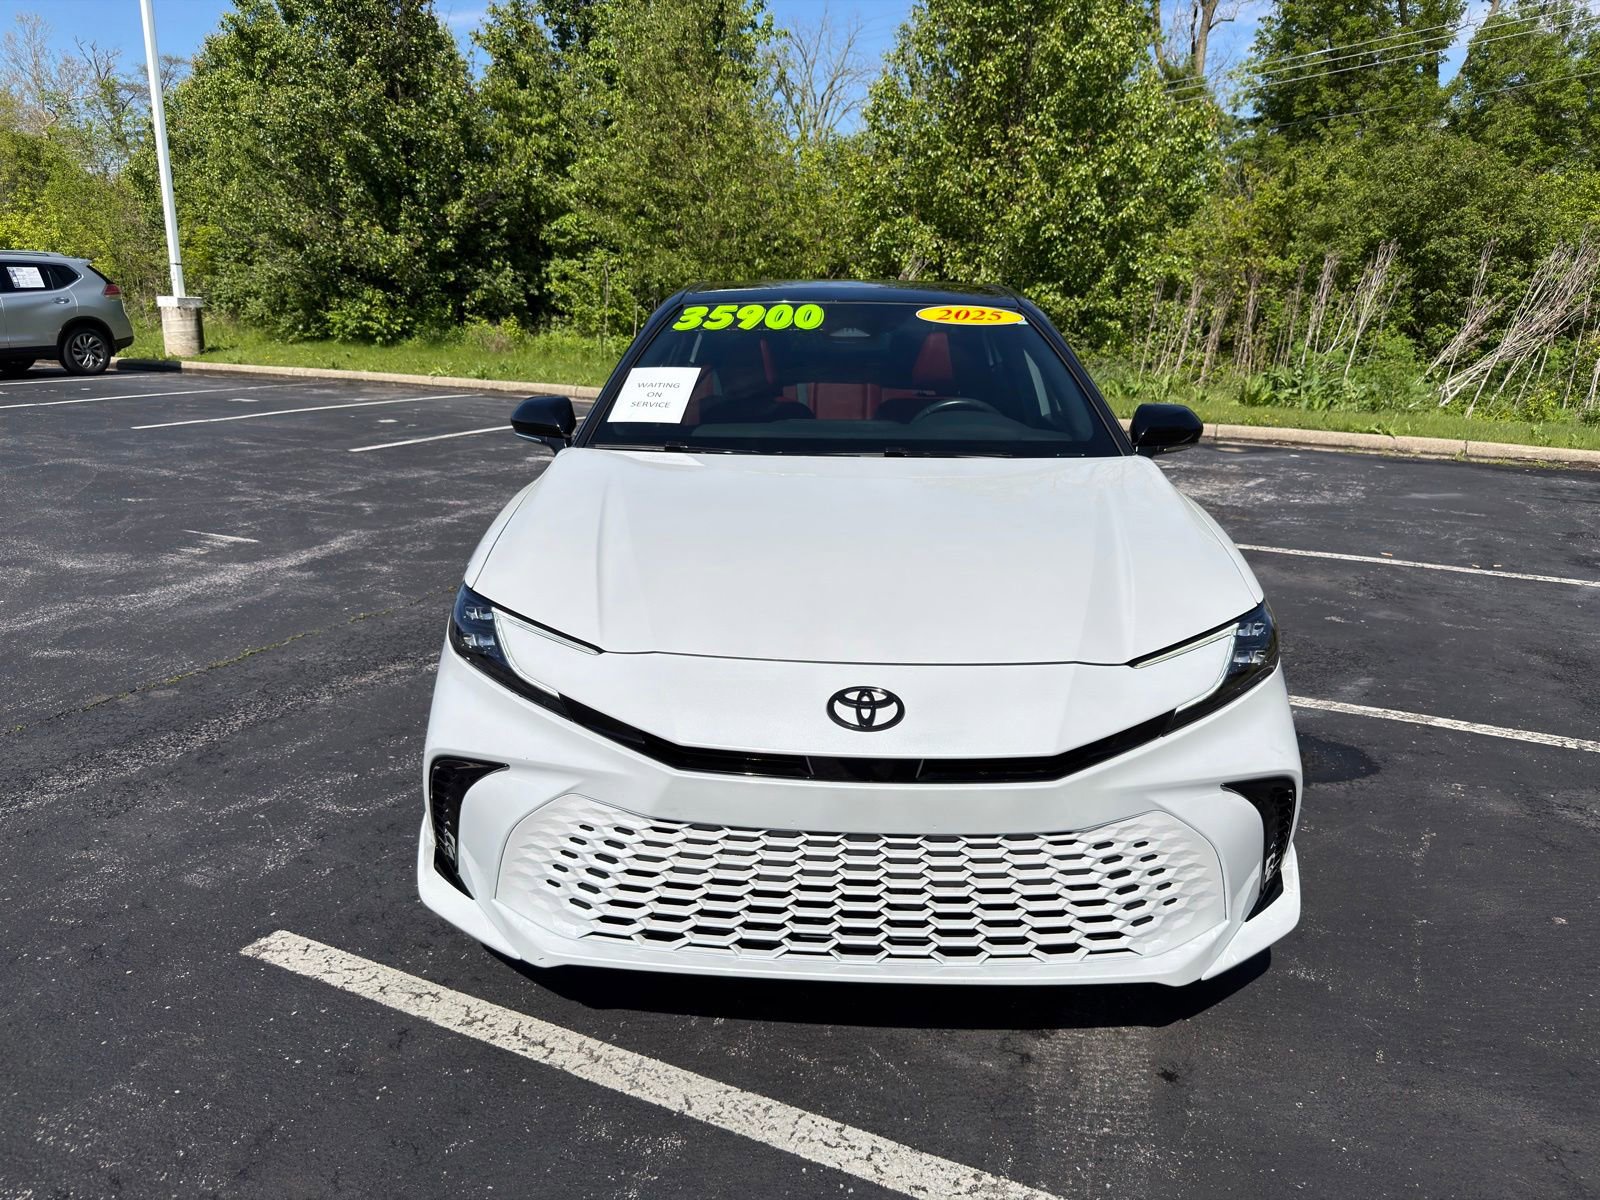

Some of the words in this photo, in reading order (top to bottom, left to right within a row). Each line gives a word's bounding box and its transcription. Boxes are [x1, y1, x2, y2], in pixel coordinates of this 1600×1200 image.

[672, 303, 825, 331] 35900
[936, 309, 1003, 321] 2025
[630, 401, 672, 409] SERVICE
